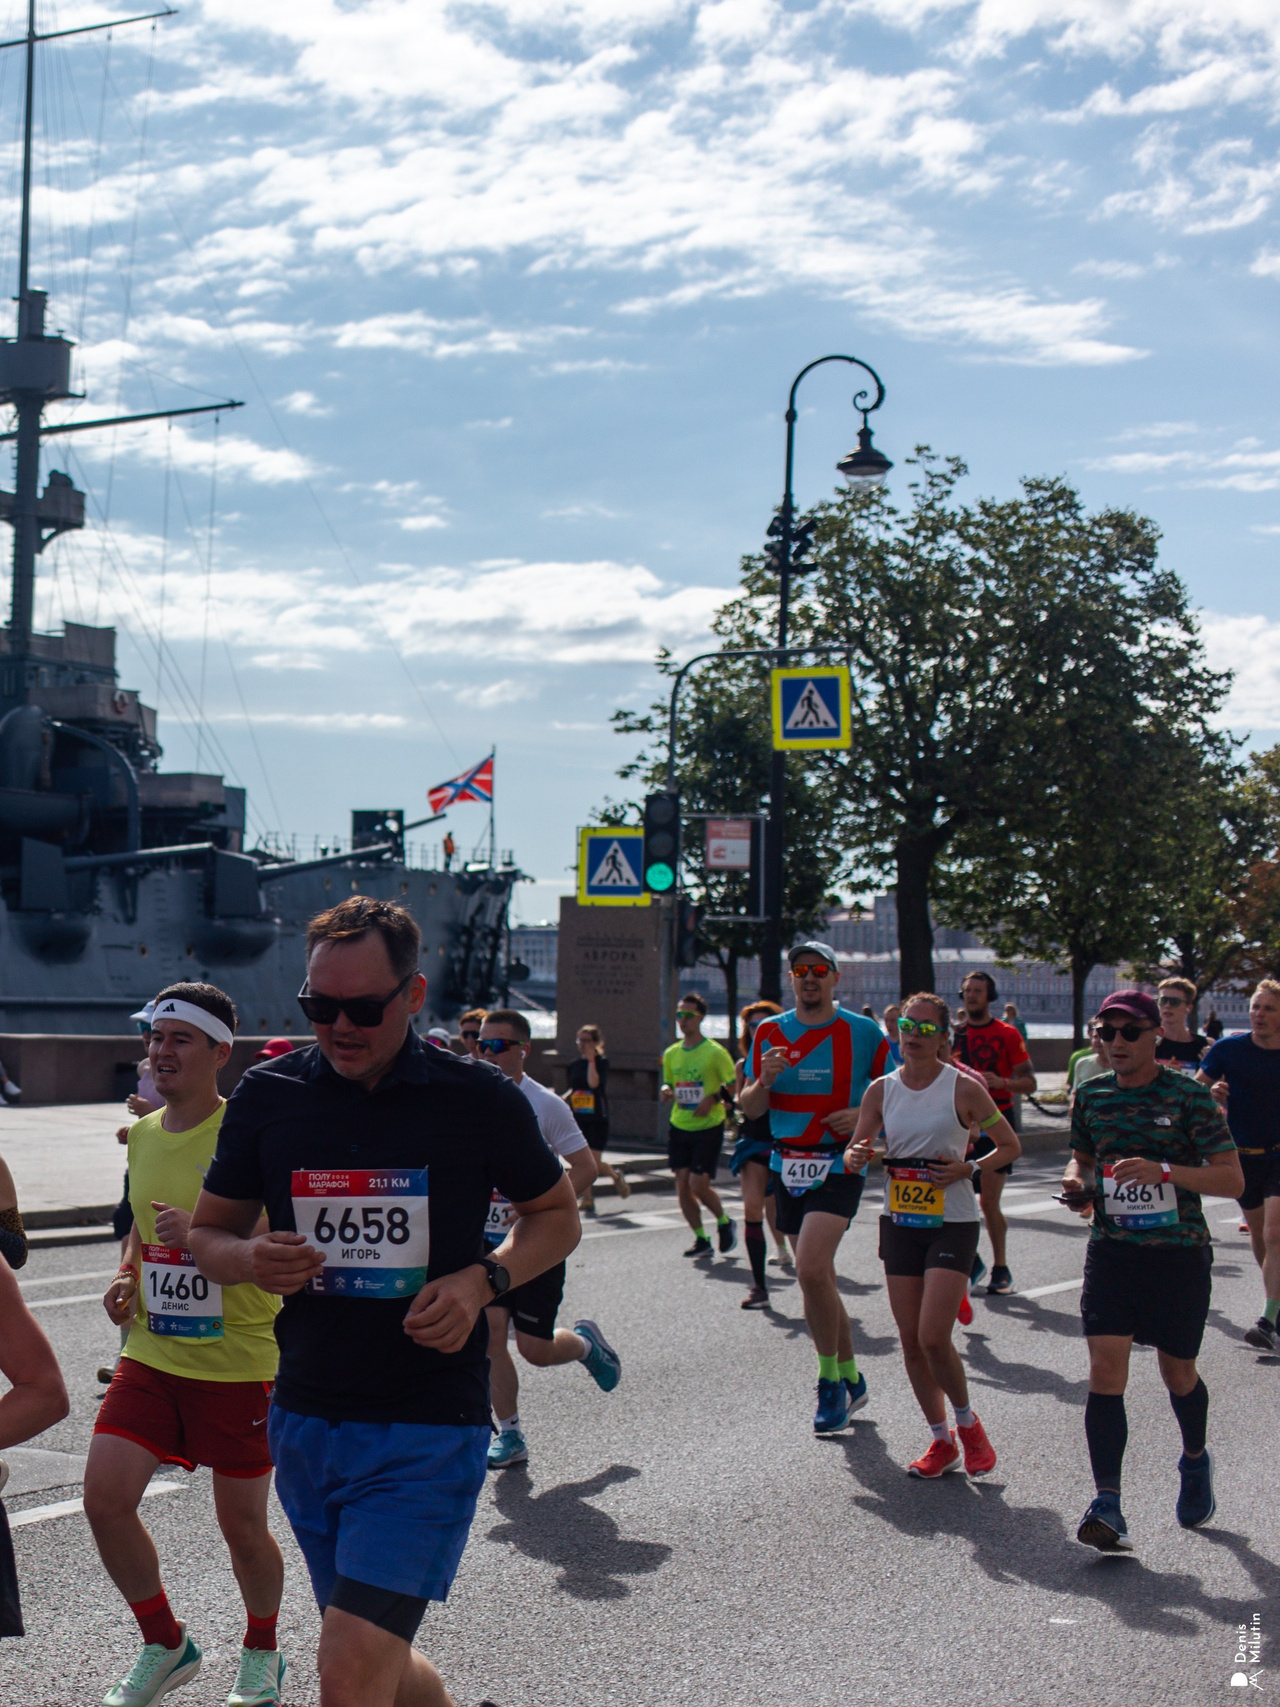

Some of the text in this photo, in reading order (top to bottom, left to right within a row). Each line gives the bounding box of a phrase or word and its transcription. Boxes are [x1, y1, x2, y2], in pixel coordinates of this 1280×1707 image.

[369, 1178, 388, 1189] 21,1
[1112, 1182, 1165, 1203] 4861
[894, 1184, 936, 1205] 1624
[314, 1206, 410, 1245] 6658
[341, 1249, 381, 1260] ИГОРЬ
[149, 1271, 208, 1301] 1460
[161, 1301, 190, 1311] ДЕНИС
